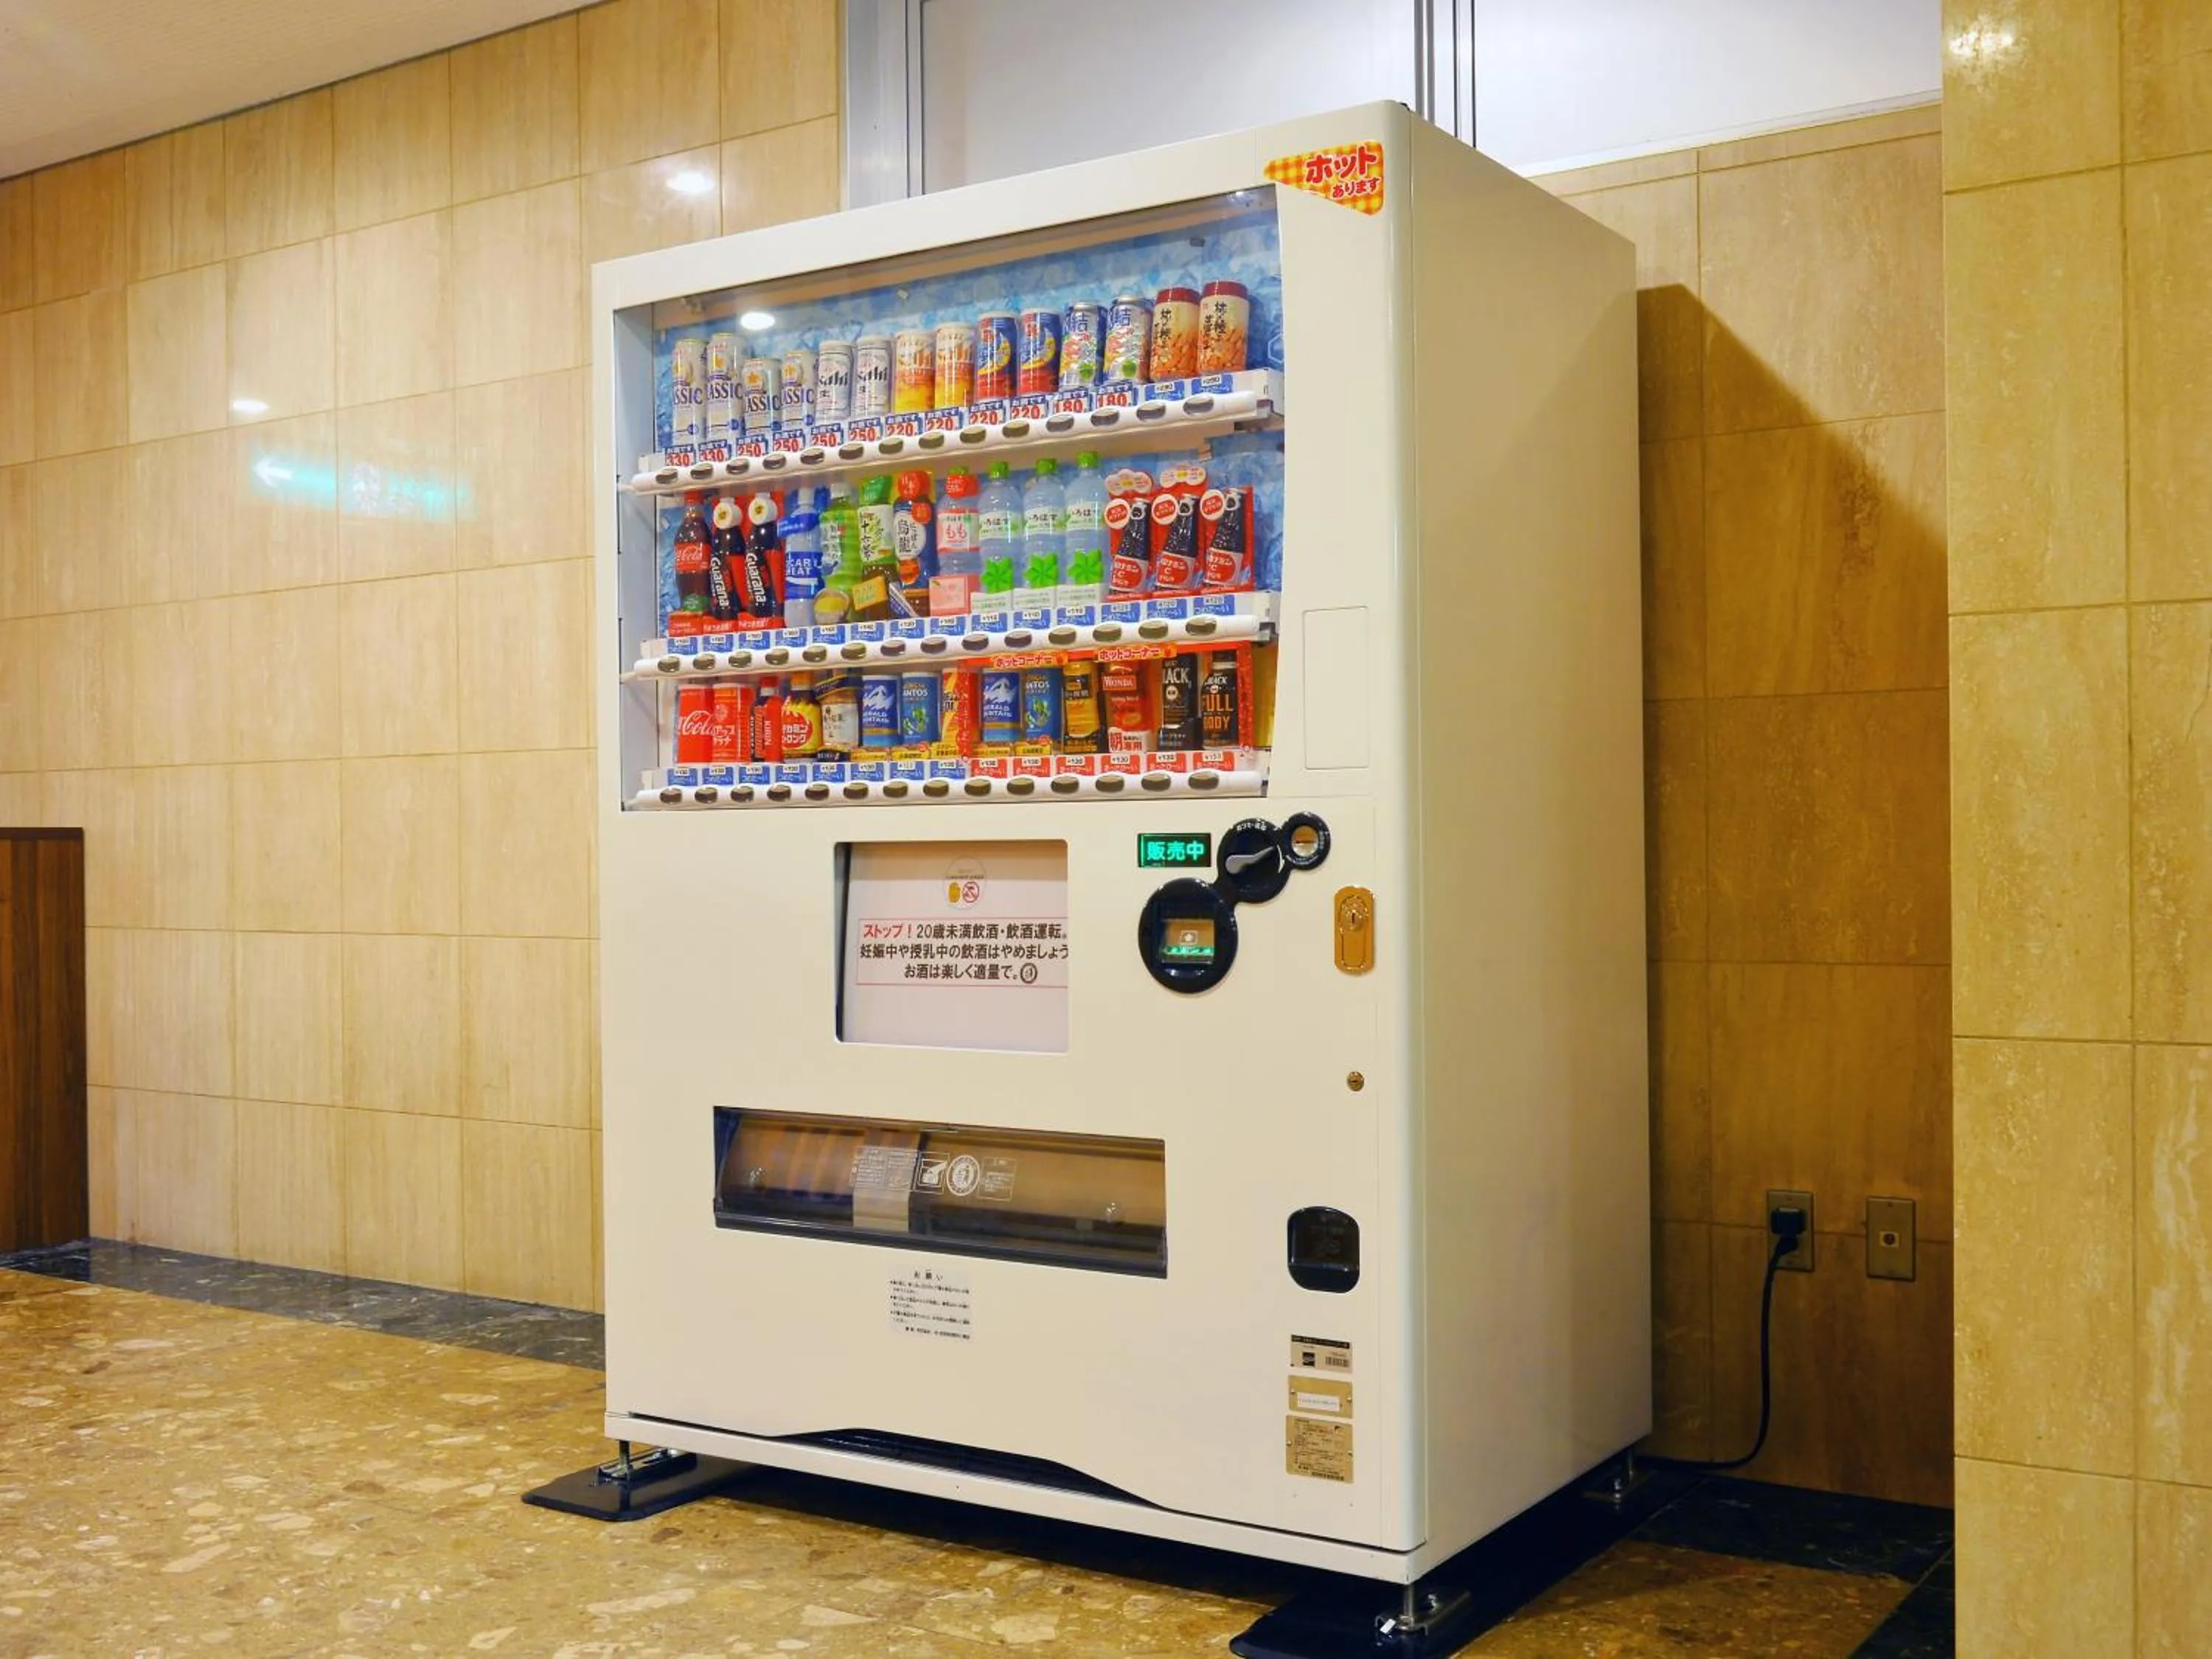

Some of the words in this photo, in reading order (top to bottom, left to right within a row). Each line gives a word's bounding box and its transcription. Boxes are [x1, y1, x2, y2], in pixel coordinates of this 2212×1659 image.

[1306, 145, 1377, 184] ホット
[1332, 176, 1380, 198] あります
[970, 410, 998, 425] 220
[1012, 405, 1040, 420] 220
[887, 422, 914, 437] 220
[926, 415, 954, 431] 220
[946, 524, 967, 539] もも
[710, 557, 729, 607] Guarana
[746, 552, 766, 603] Guarana
[995, 655, 1054, 669] ホットコーナー
[1099, 647, 1161, 661] ホットコーナー
[1147, 840, 1205, 862] 販売中
[860, 943, 1068, 960] 妊娠中や授乳中の飲酒はやめましょう
[904, 963, 1018, 980] お酒は楽しく適量で。
